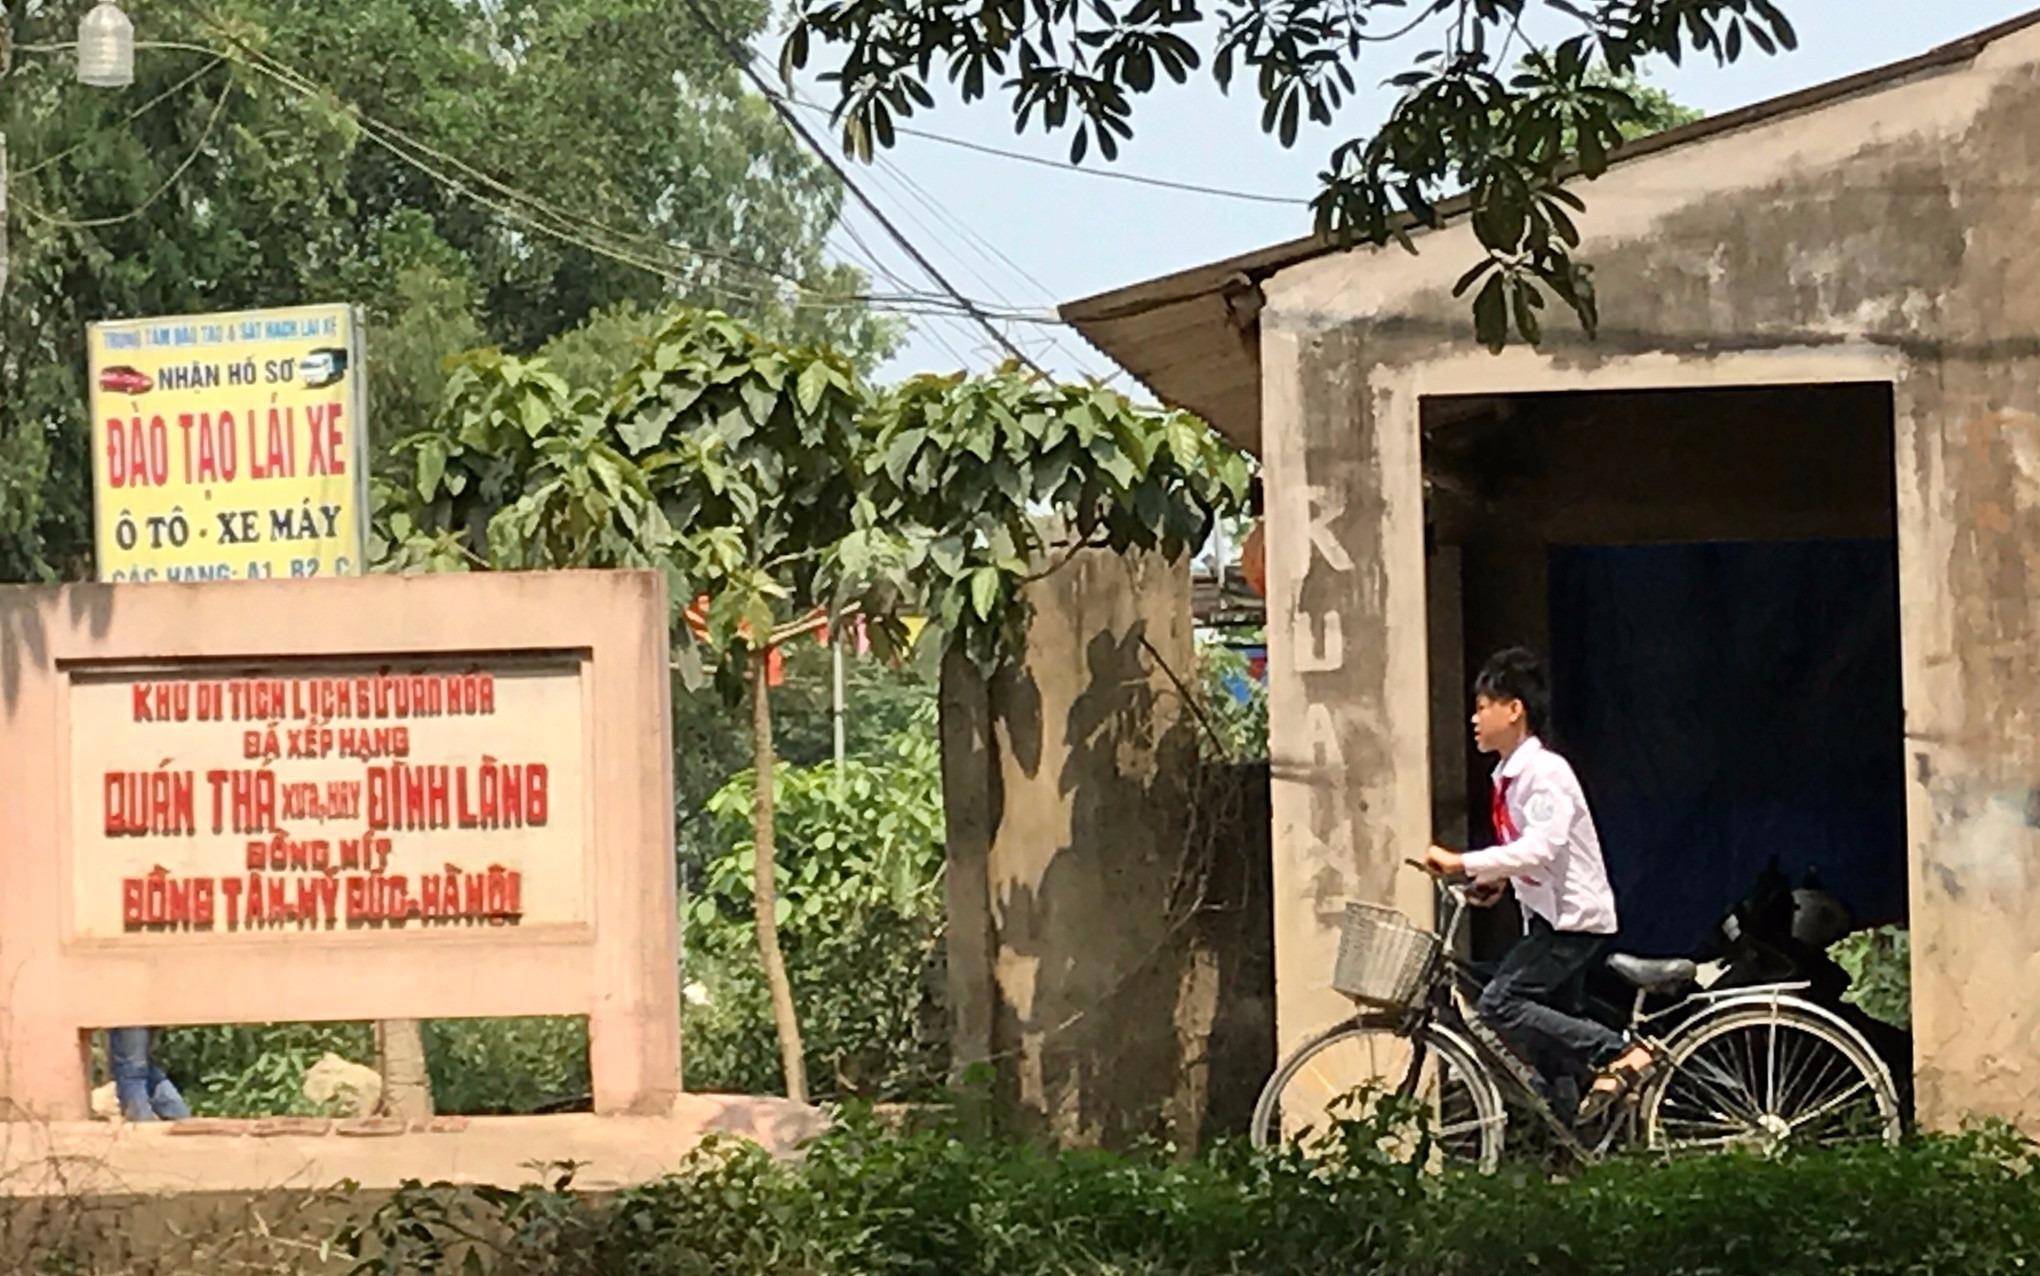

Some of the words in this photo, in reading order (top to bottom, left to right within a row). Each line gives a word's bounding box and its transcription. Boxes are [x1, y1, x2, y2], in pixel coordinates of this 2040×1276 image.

[158, 360, 220, 393] NHẬN
[265, 358, 296, 382] SƠ
[106, 401, 168, 488] ĐÀO
[178, 410, 237, 500] TẠO
[248, 392, 296, 479] LÁI
[306, 403, 346, 477] XE
[116, 509, 138, 551] Ô
[146, 505, 190, 549] TÔ
[216, 510, 261, 544] XE
[269, 497, 342, 541] MÁY
[133, 683, 190, 722] KHU
[196, 683, 224, 722] DI
[292, 681, 352, 726] LỊCH
[338, 727, 410, 763] HẠNG
[103, 757, 196, 837] QUÁN
[366, 760, 451, 831] ĐÌNH
[455, 754, 549, 831] LÀNG
[466, 863, 523, 926] NỘI
